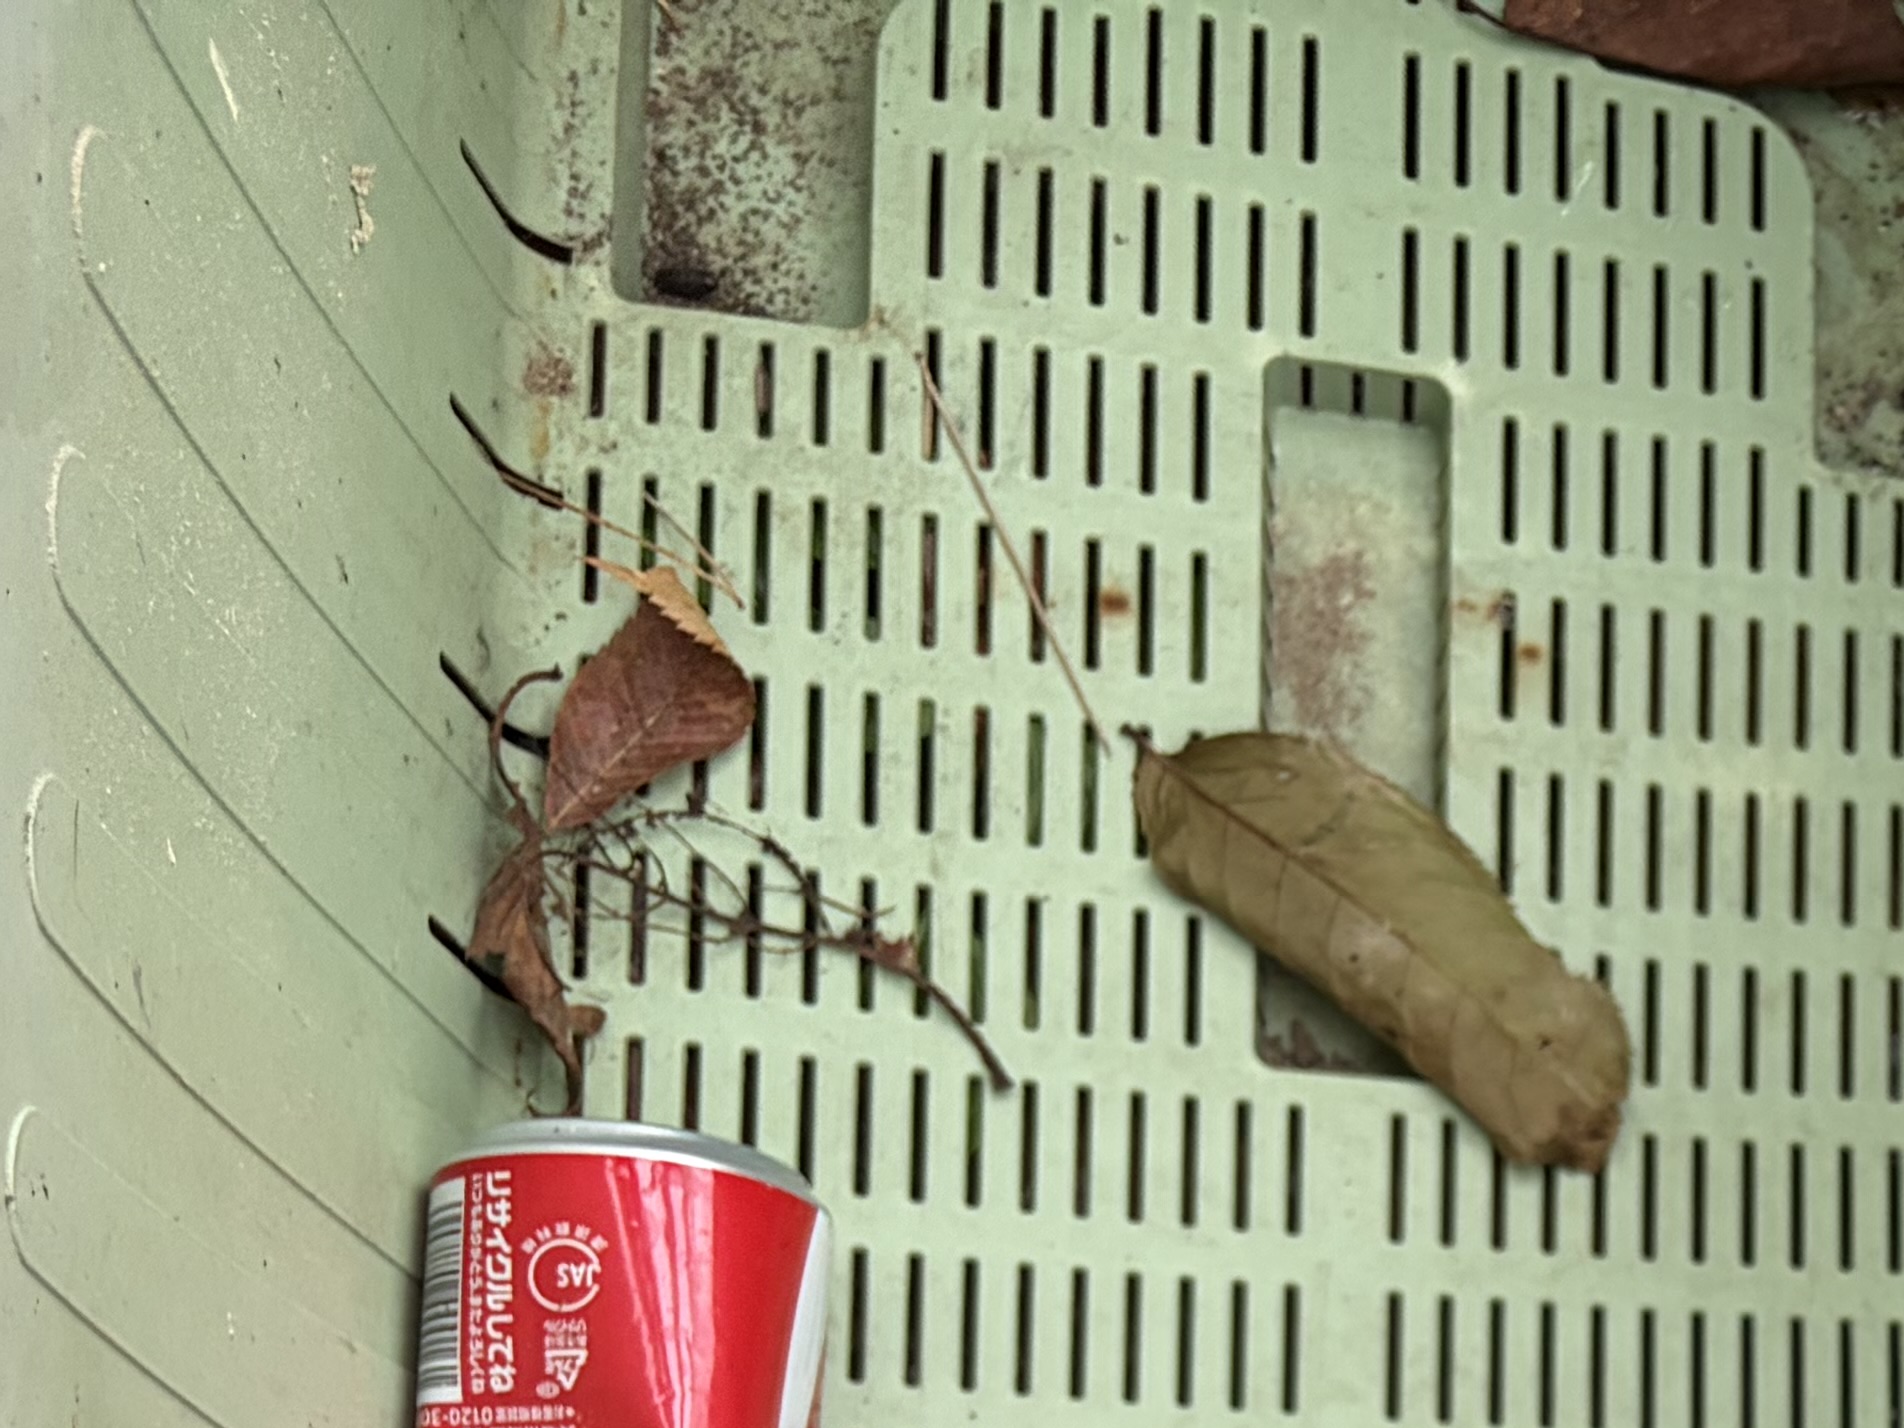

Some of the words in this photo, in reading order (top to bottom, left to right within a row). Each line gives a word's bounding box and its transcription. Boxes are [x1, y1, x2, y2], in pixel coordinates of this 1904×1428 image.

[486, 1170, 515, 1394] リサイクルしてね
[556, 1262, 602, 1288] JAS
